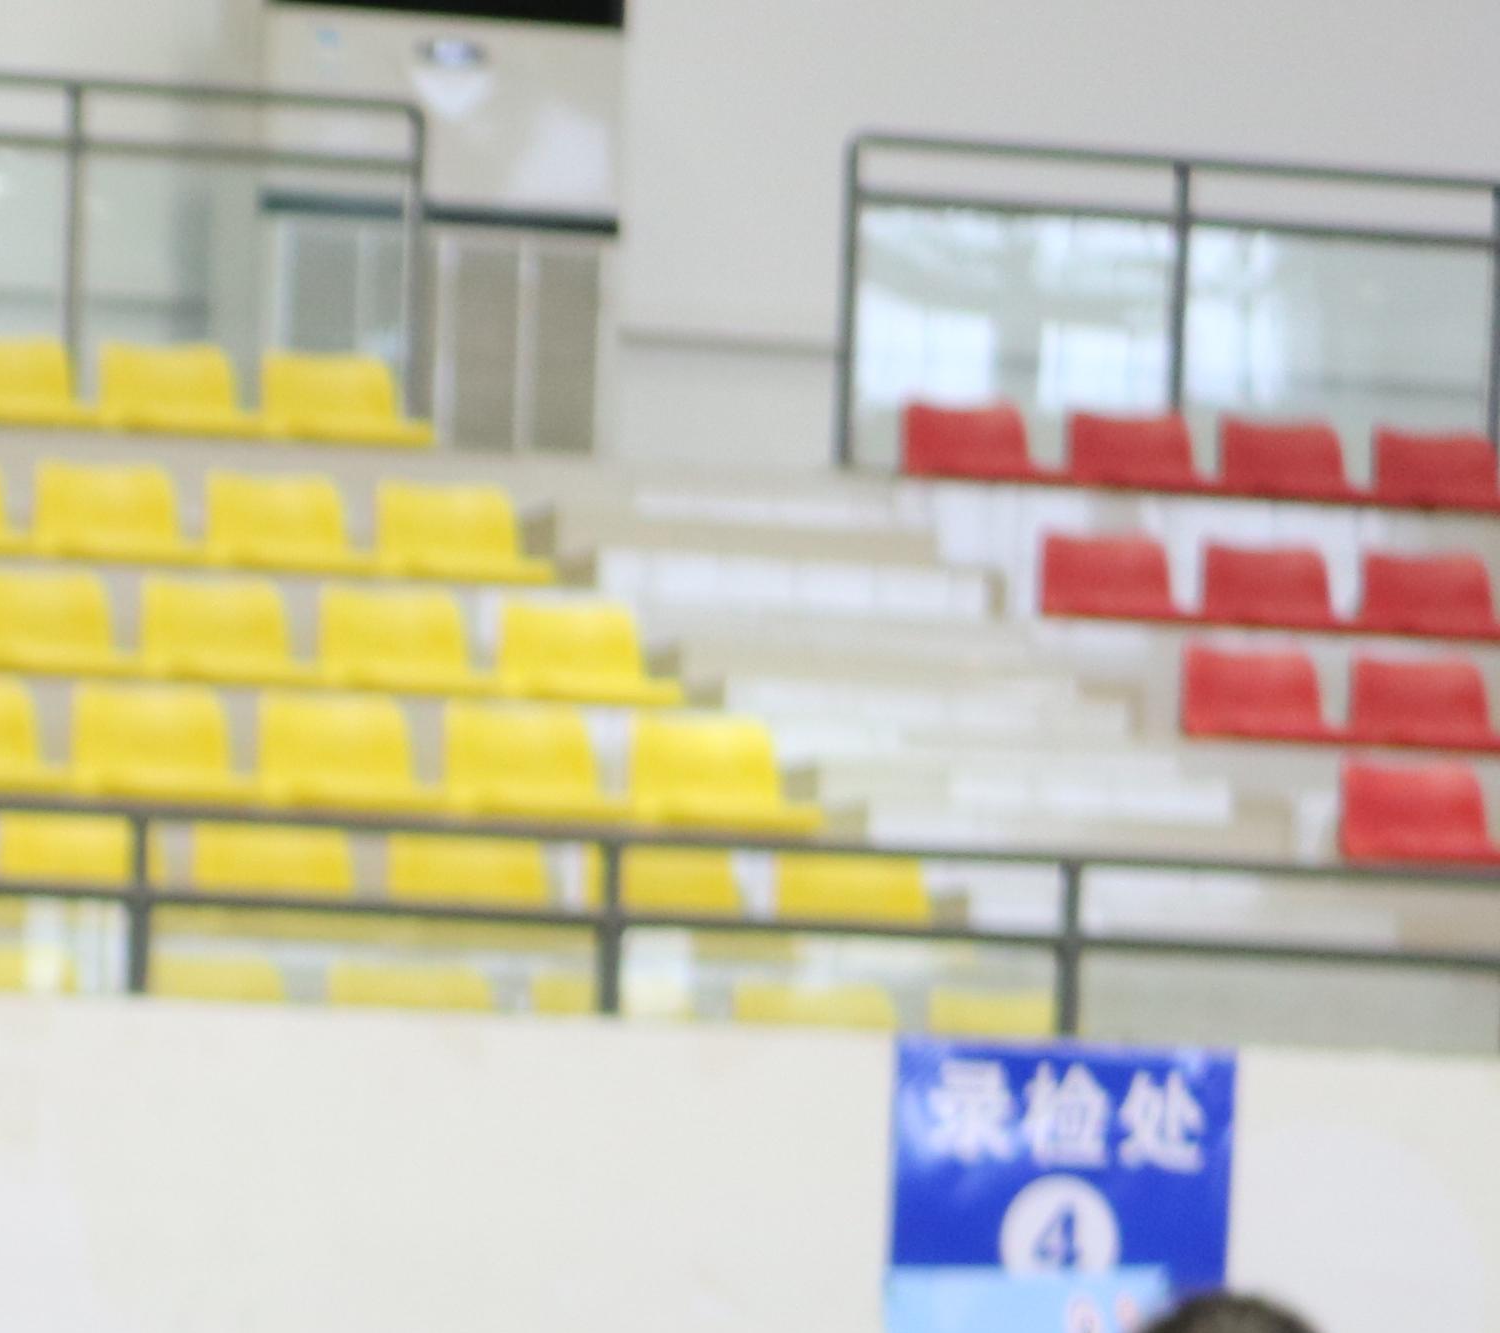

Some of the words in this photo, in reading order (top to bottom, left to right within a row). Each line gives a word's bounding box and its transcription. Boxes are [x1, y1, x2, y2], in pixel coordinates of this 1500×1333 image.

[927, 1058, 1205, 1174] 录检处
[1034, 1202, 1083, 1271] 4
